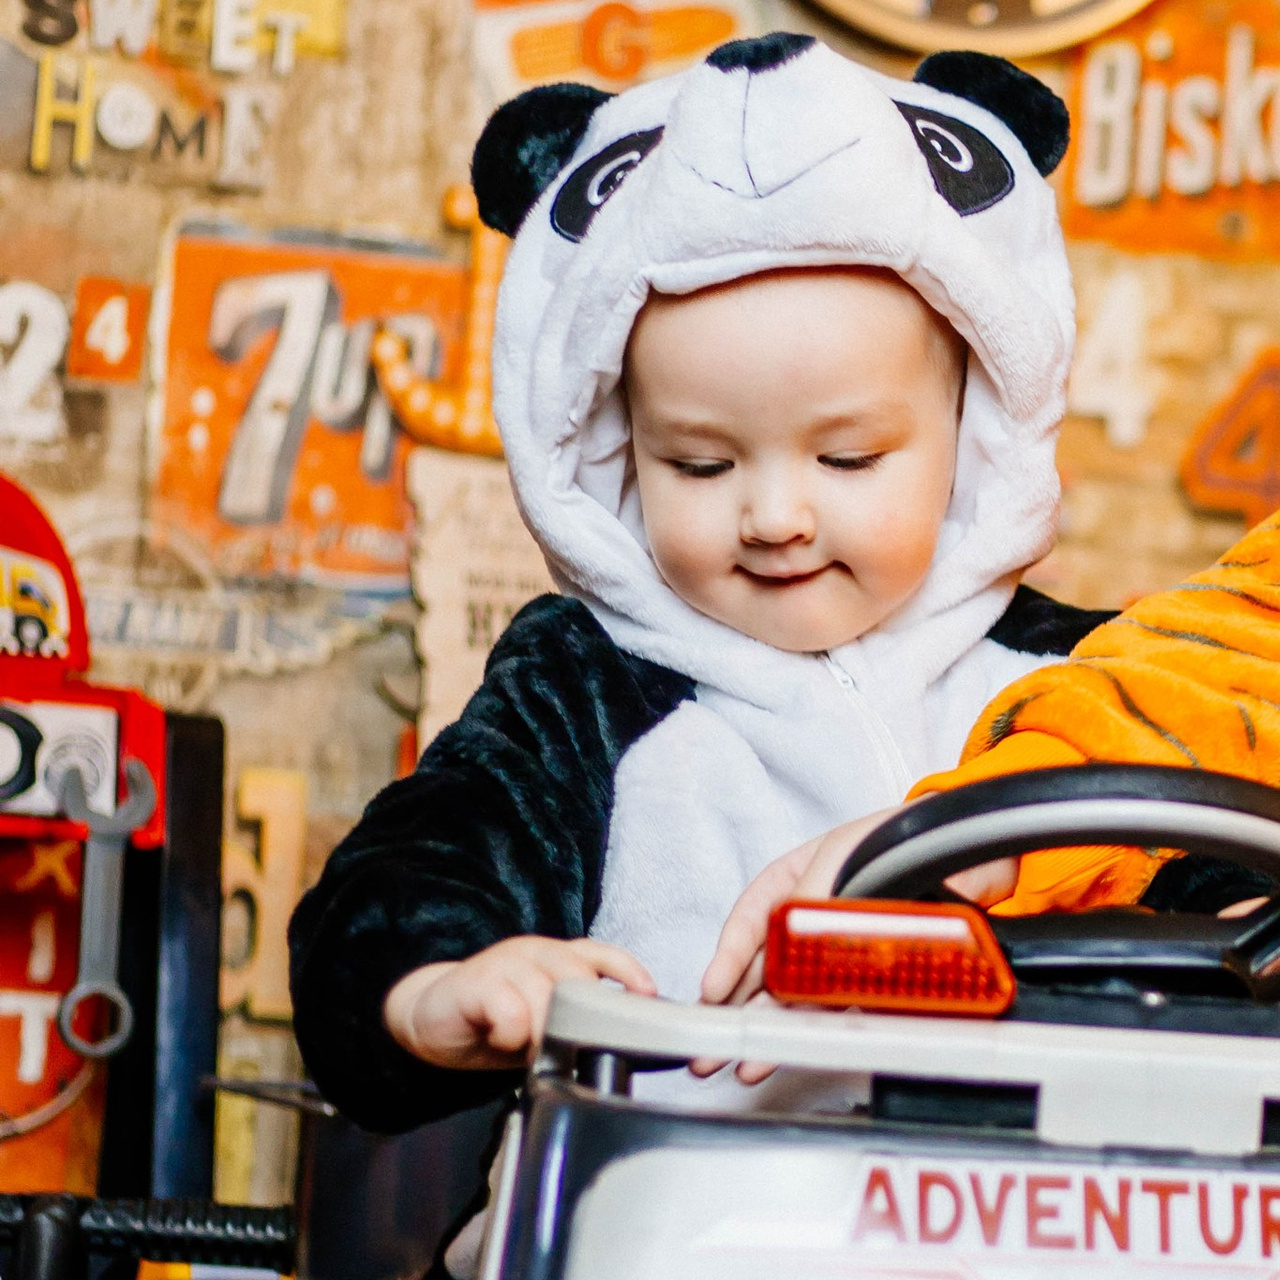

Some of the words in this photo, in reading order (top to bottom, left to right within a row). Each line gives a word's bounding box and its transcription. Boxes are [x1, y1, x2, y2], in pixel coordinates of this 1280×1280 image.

[581, 2, 643, 83] G
[29, 50, 282, 190] HOME
[85, 295, 131, 362] 4
